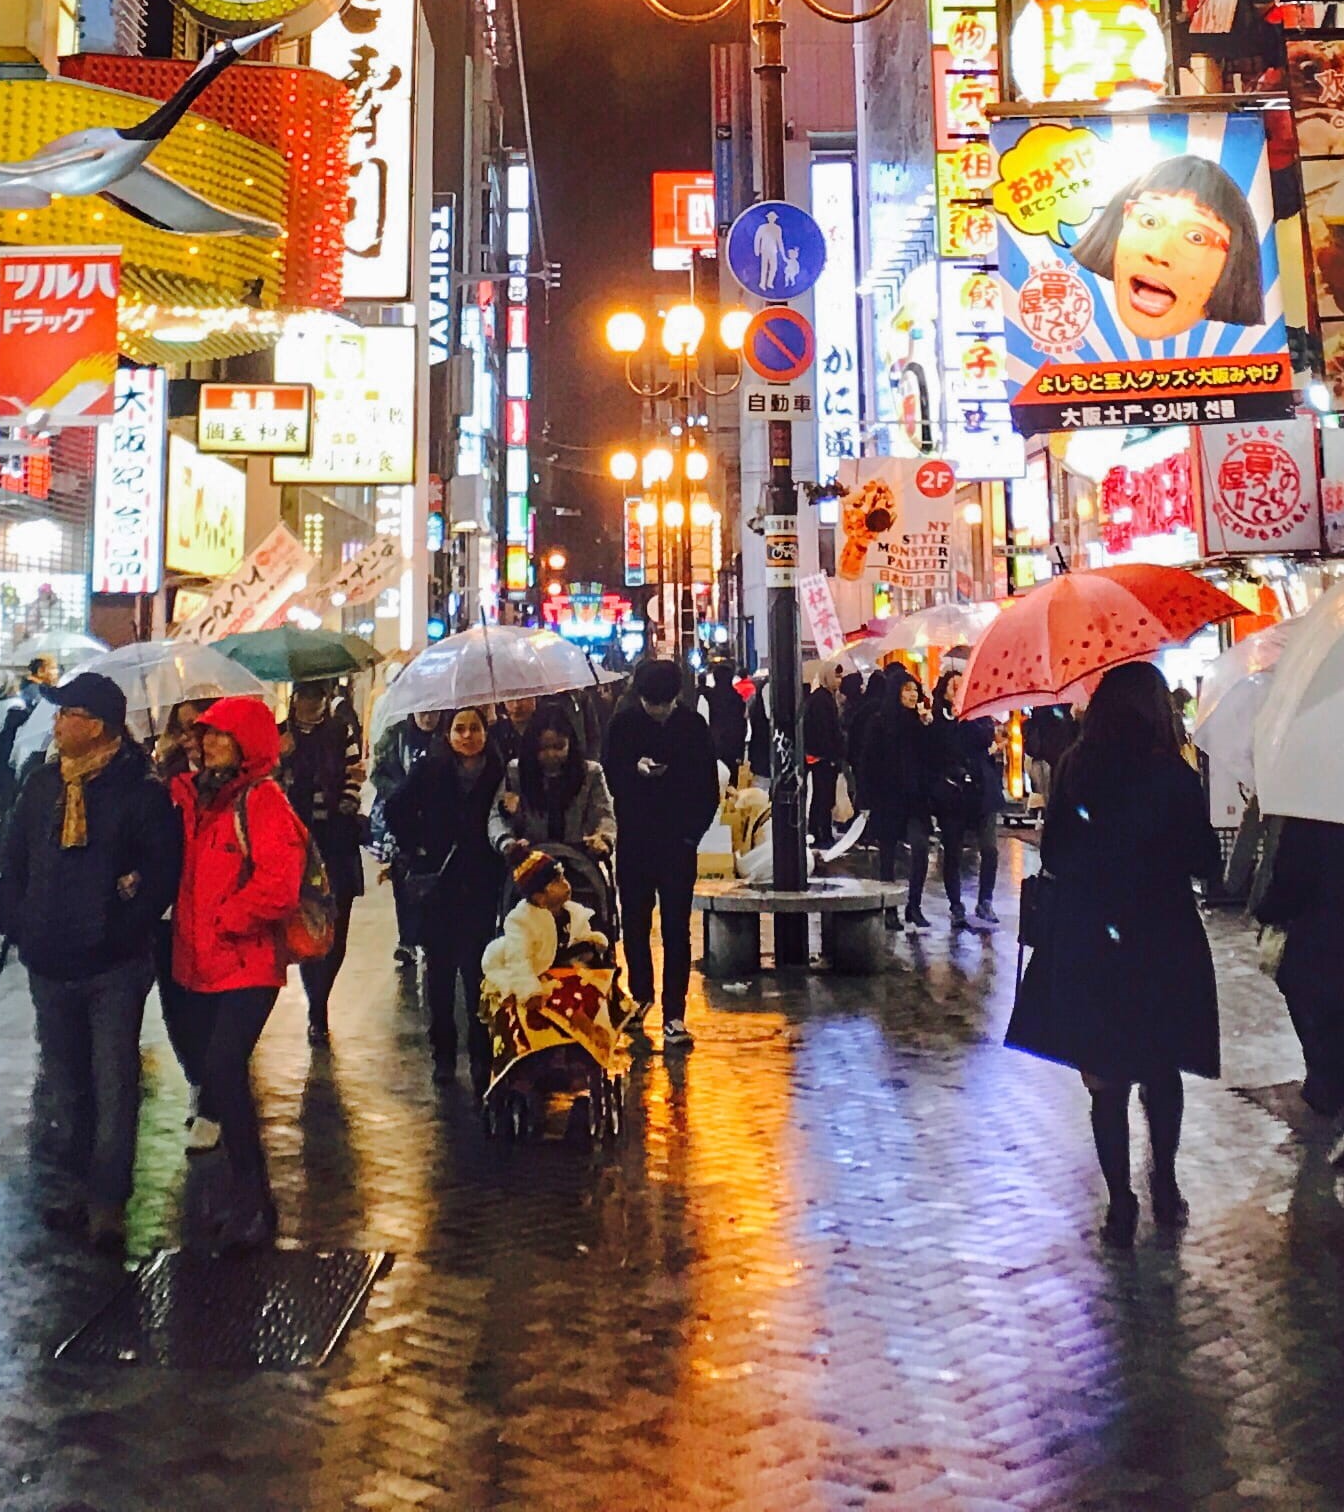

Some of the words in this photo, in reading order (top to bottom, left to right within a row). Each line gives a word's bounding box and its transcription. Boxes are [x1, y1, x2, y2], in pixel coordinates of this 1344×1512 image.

[2, 263, 116, 301] ツルハ
[0, 305, 95, 335] ドラッグ
[747, 392, 811, 414] 自動車
[920, 470, 951, 489] 2F
[927, 521, 951, 533] NY
[901, 534, 950, 546] STYLE
[876, 543, 949, 558] MONSTER
